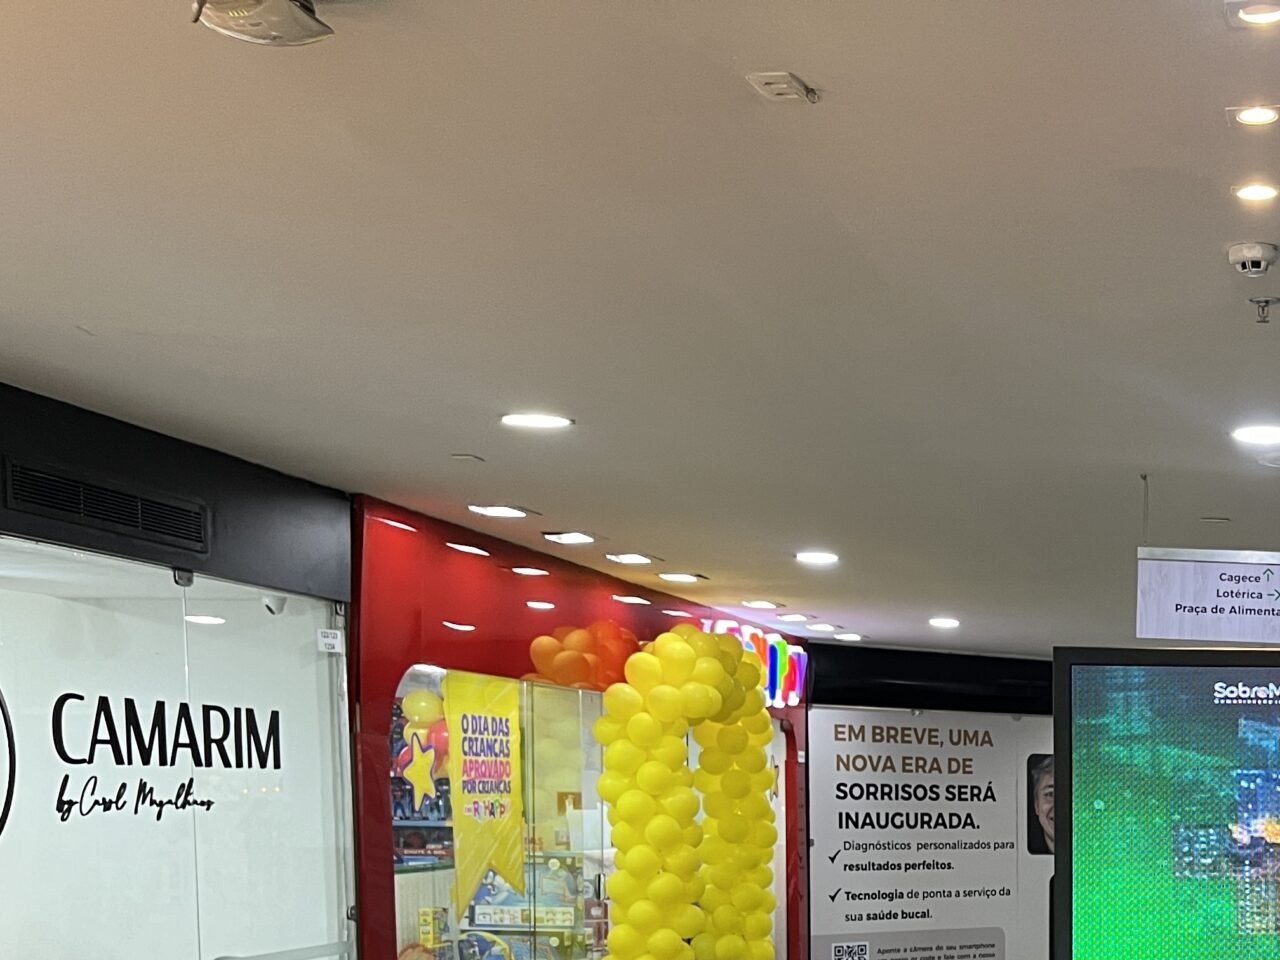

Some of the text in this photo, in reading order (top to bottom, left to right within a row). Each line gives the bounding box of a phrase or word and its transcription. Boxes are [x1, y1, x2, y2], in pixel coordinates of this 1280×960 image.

[1219, 572, 1261, 585] Cagece
[1216, 588, 1263, 599] Lotérica
[1175, 603, 1207, 616] Praça
[1211, 605, 1225, 614] de
[52, 693, 281, 769] CAMARIM
[461, 713, 510, 737] O DIA DAS
[834, 724, 994, 747] EM BREVE, UMA
[463, 759, 511, 779] APROVADO
[836, 754, 973, 775] NOVA ERA DE
[462, 779, 477, 794] POR
[835, 781, 997, 802] SORRISOS SERÁ
[56, 774, 79, 821] by
[838, 812, 980, 829] INAUGURADA.
[843, 840, 1015, 853] Diagnósticos personalizados para
[843, 860, 954, 872] resultados perfeitos.
[844, 887, 1011, 902] Tecnologia de ponta a serviço da
[844, 909, 932, 922] sua saúde bucal.
[877, 947, 901, 955] Aponte
